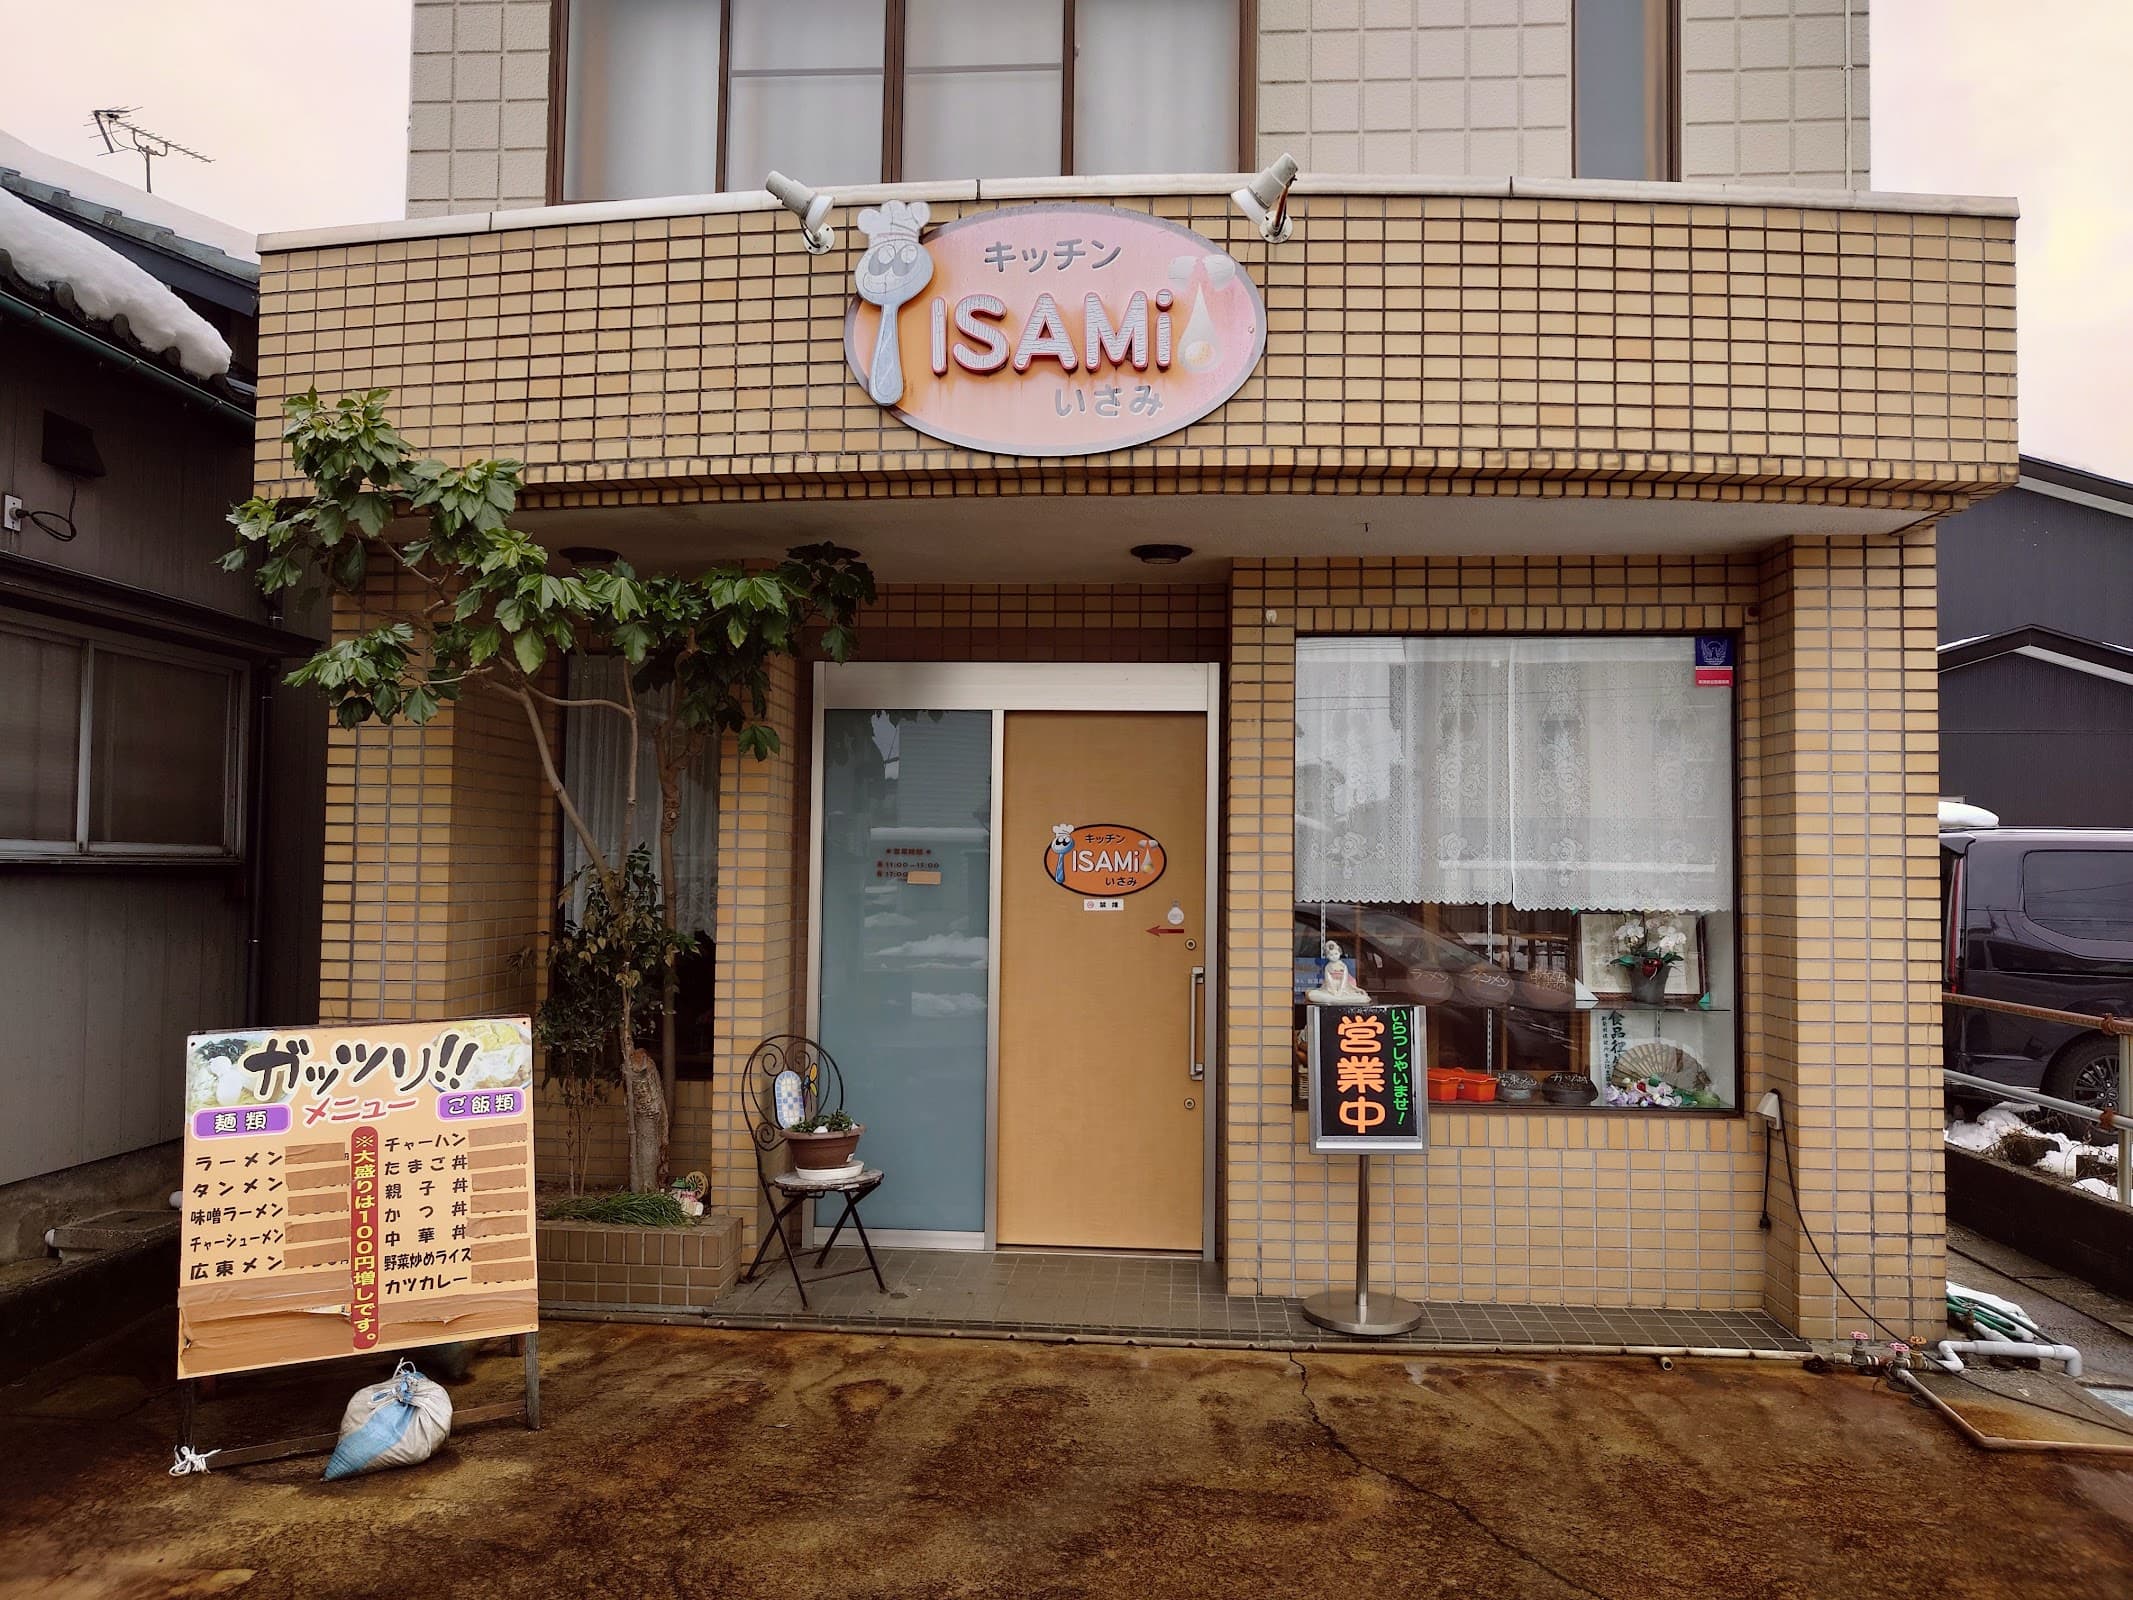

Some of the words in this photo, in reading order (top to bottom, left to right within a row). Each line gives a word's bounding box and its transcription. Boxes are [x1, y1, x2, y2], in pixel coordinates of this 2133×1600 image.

[984, 238, 1121, 273] キッチン
[930, 288, 1174, 376] ISAMi
[1054, 384, 1164, 418] いさみ
[1084, 833, 1126, 844] キッチン
[1071, 850, 1140, 873] ISAMi
[1105, 876, 1137, 887] いさみ
[244, 1033, 479, 1096] ガッツリ!!
[1336, 1014, 1386, 1134] 営業中
[302, 1097, 417, 1125] メニュー
[447, 1093, 515, 1115] ご飯類
[213, 1109, 268, 1133] 麺類
[384, 1132, 466, 1152] チャーハン
[195, 1151, 283, 1171] ラーメン
[384, 1154, 468, 1176] たまご丼
[192, 1177, 283, 1198] タンメン
[384, 1178, 468, 1200] 親子丼
[190, 1203, 284, 1226] 味噌ラーメン
[384, 1201, 468, 1223] かつ丼
[189, 1229, 284, 1253] チャーシューメン
[384, 1225, 468, 1248] 中華丼
[190, 1256, 283, 1281] 広東メン
[384, 1247, 472, 1272] 野菜炒めライス
[384, 1274, 468, 1295] カツカレー
